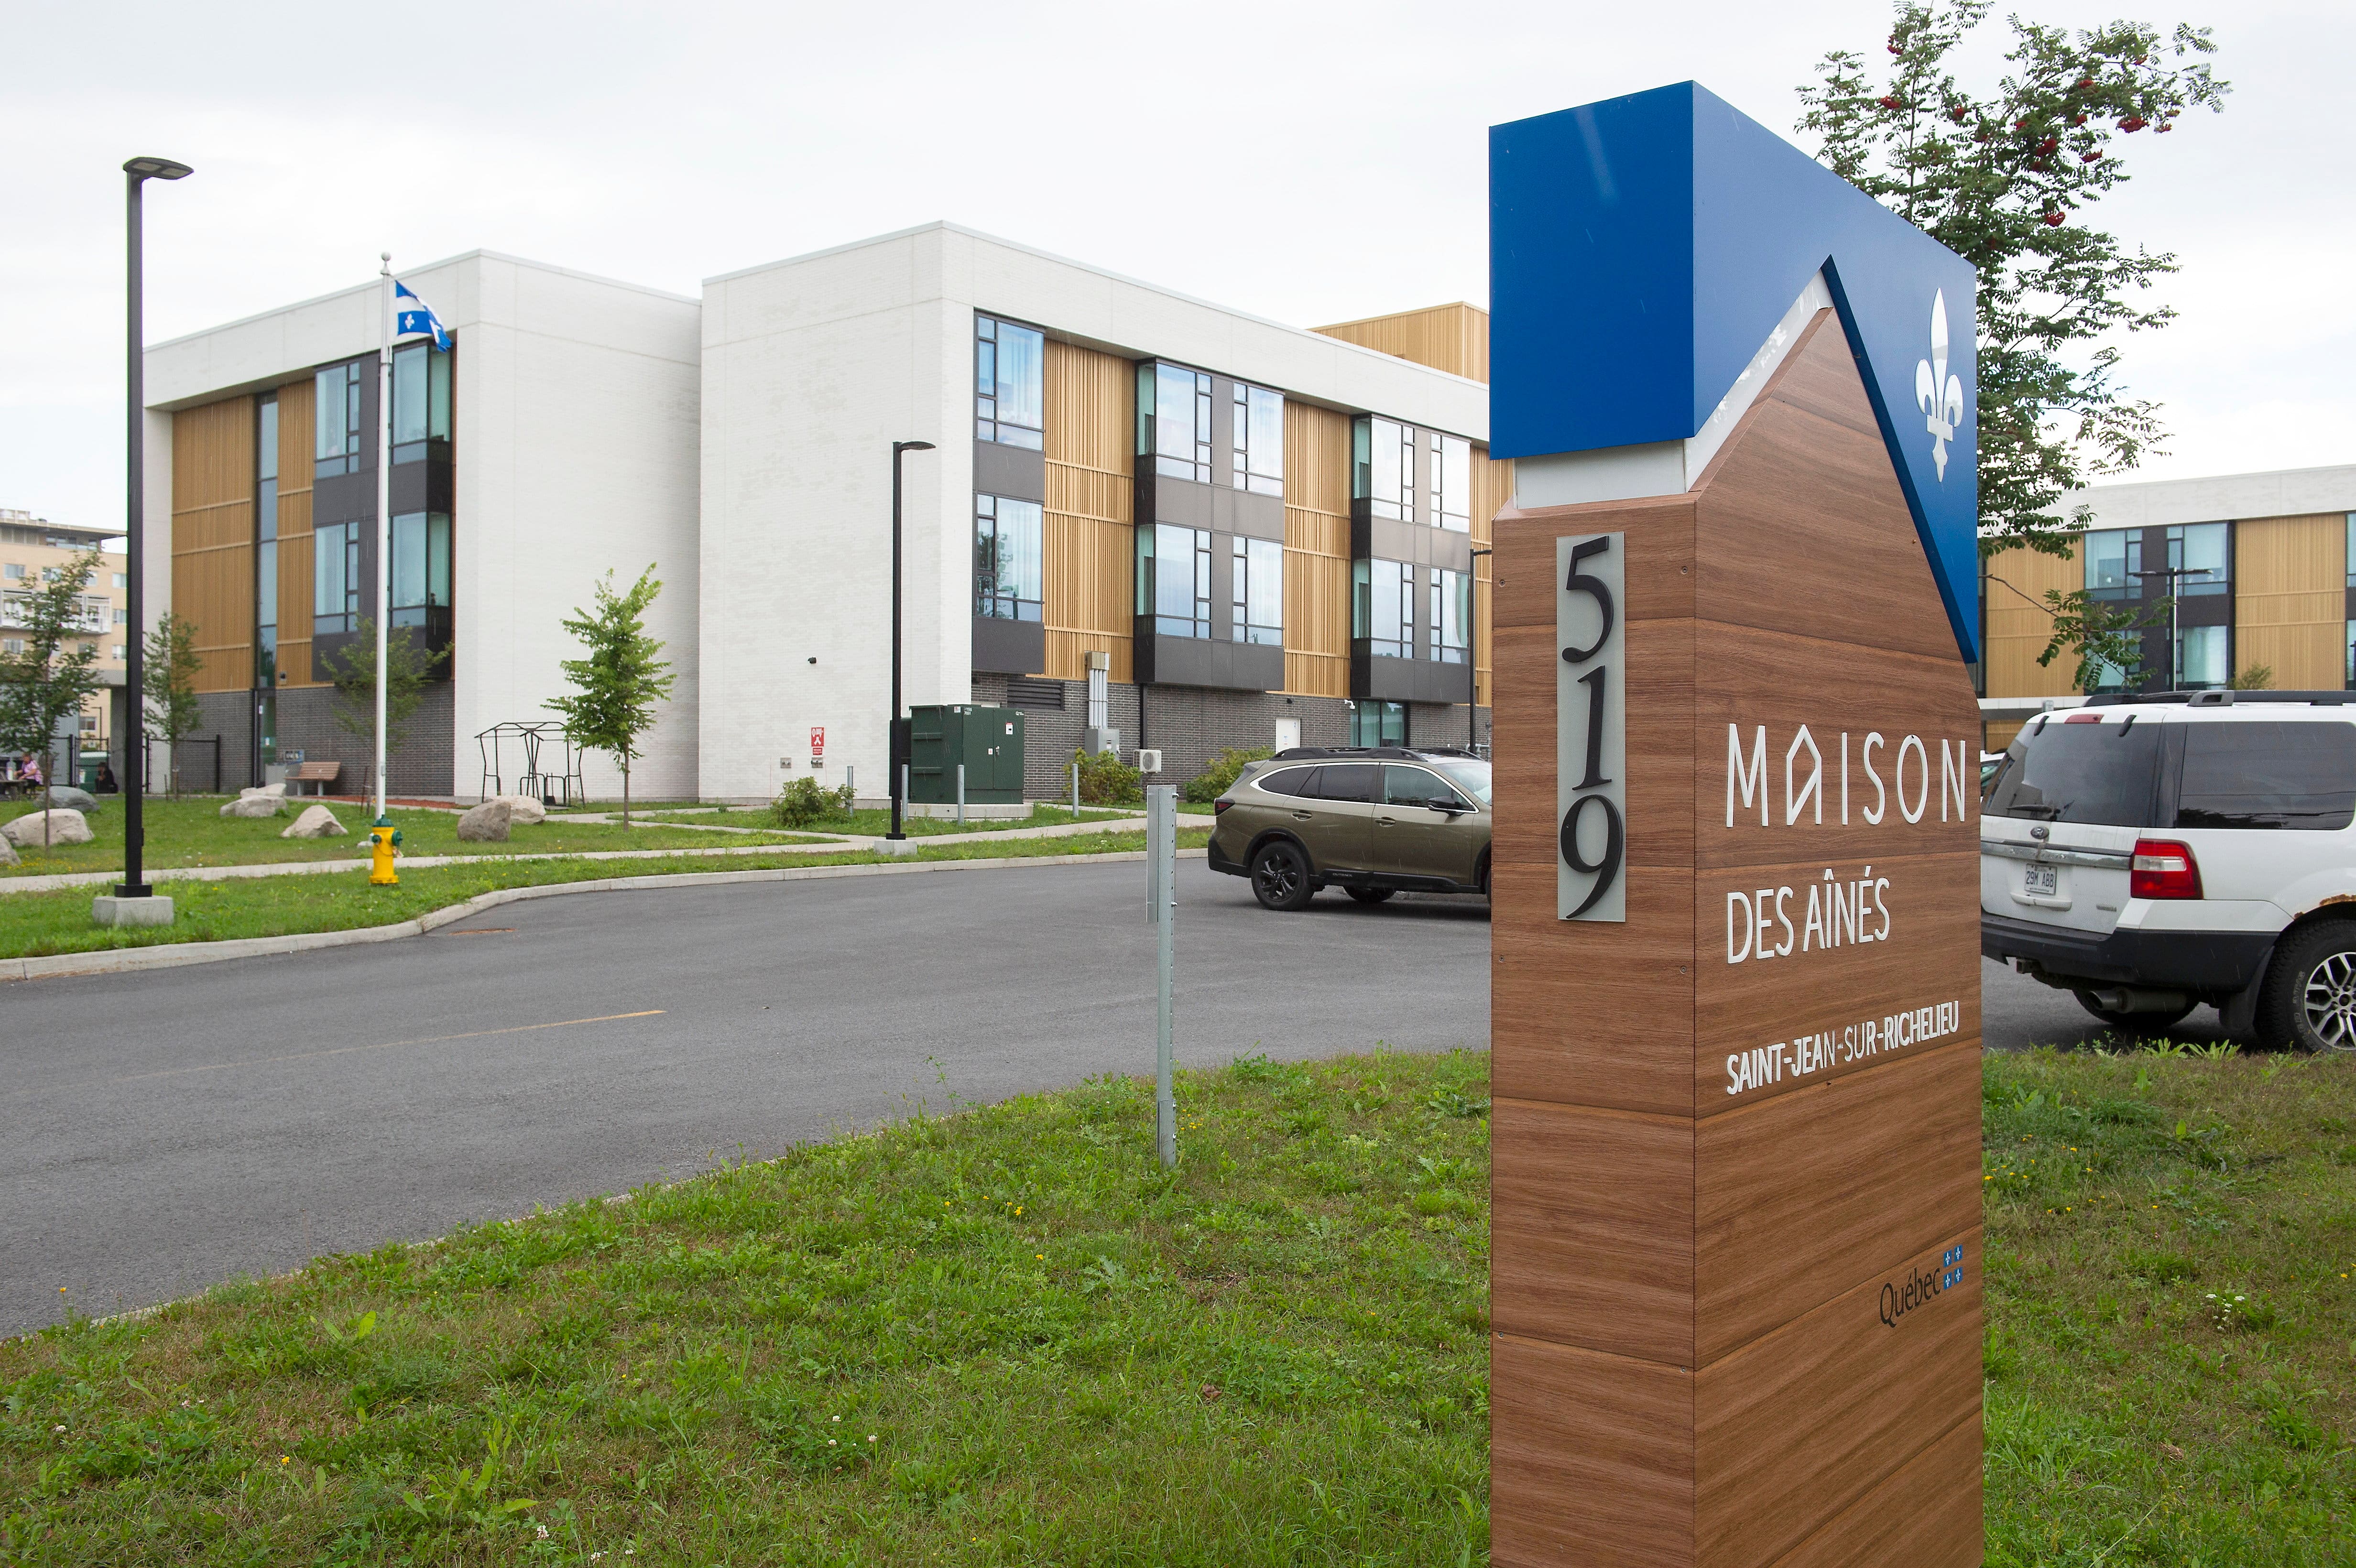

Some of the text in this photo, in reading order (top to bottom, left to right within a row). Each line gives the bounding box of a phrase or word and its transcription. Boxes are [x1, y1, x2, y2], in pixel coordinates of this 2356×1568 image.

[1560, 535, 1622, 919] 519
[1726, 723, 1965, 827] MAISON
[1727, 865, 1890, 964] DES AÎNÉS
[1726, 1000, 1959, 1095] SAINT-JEAN-SUR-RICHELIEU
[1879, 1267, 1941, 1328] Québec
